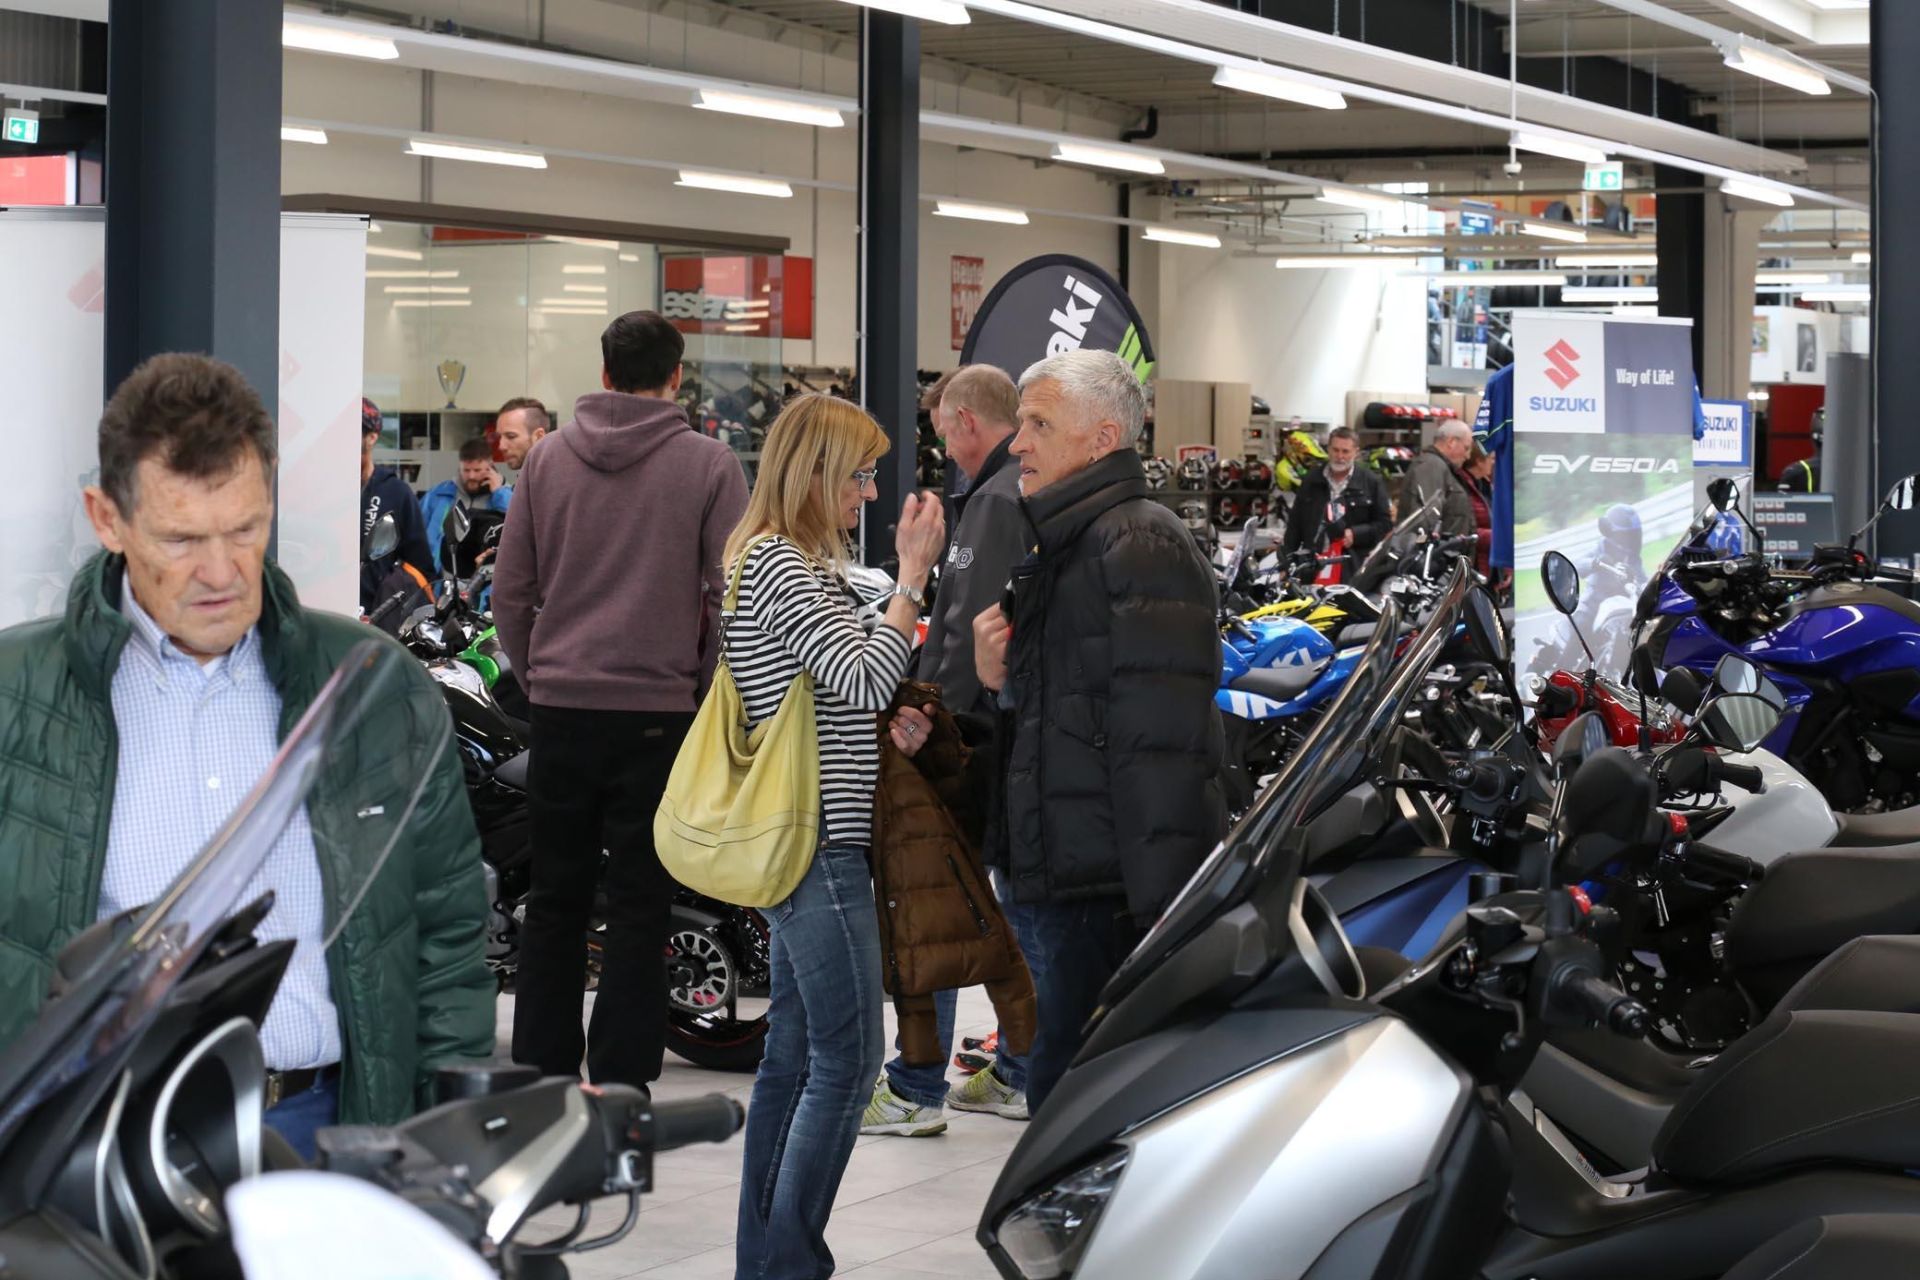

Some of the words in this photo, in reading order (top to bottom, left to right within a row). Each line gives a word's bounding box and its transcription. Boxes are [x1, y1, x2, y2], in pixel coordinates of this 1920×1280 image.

[1616, 368, 1638, 387] Way
[1640, 369, 1651, 385] of
[1653, 369, 1675, 386] Life!
[1529, 396, 1596, 412] SUZUKI
